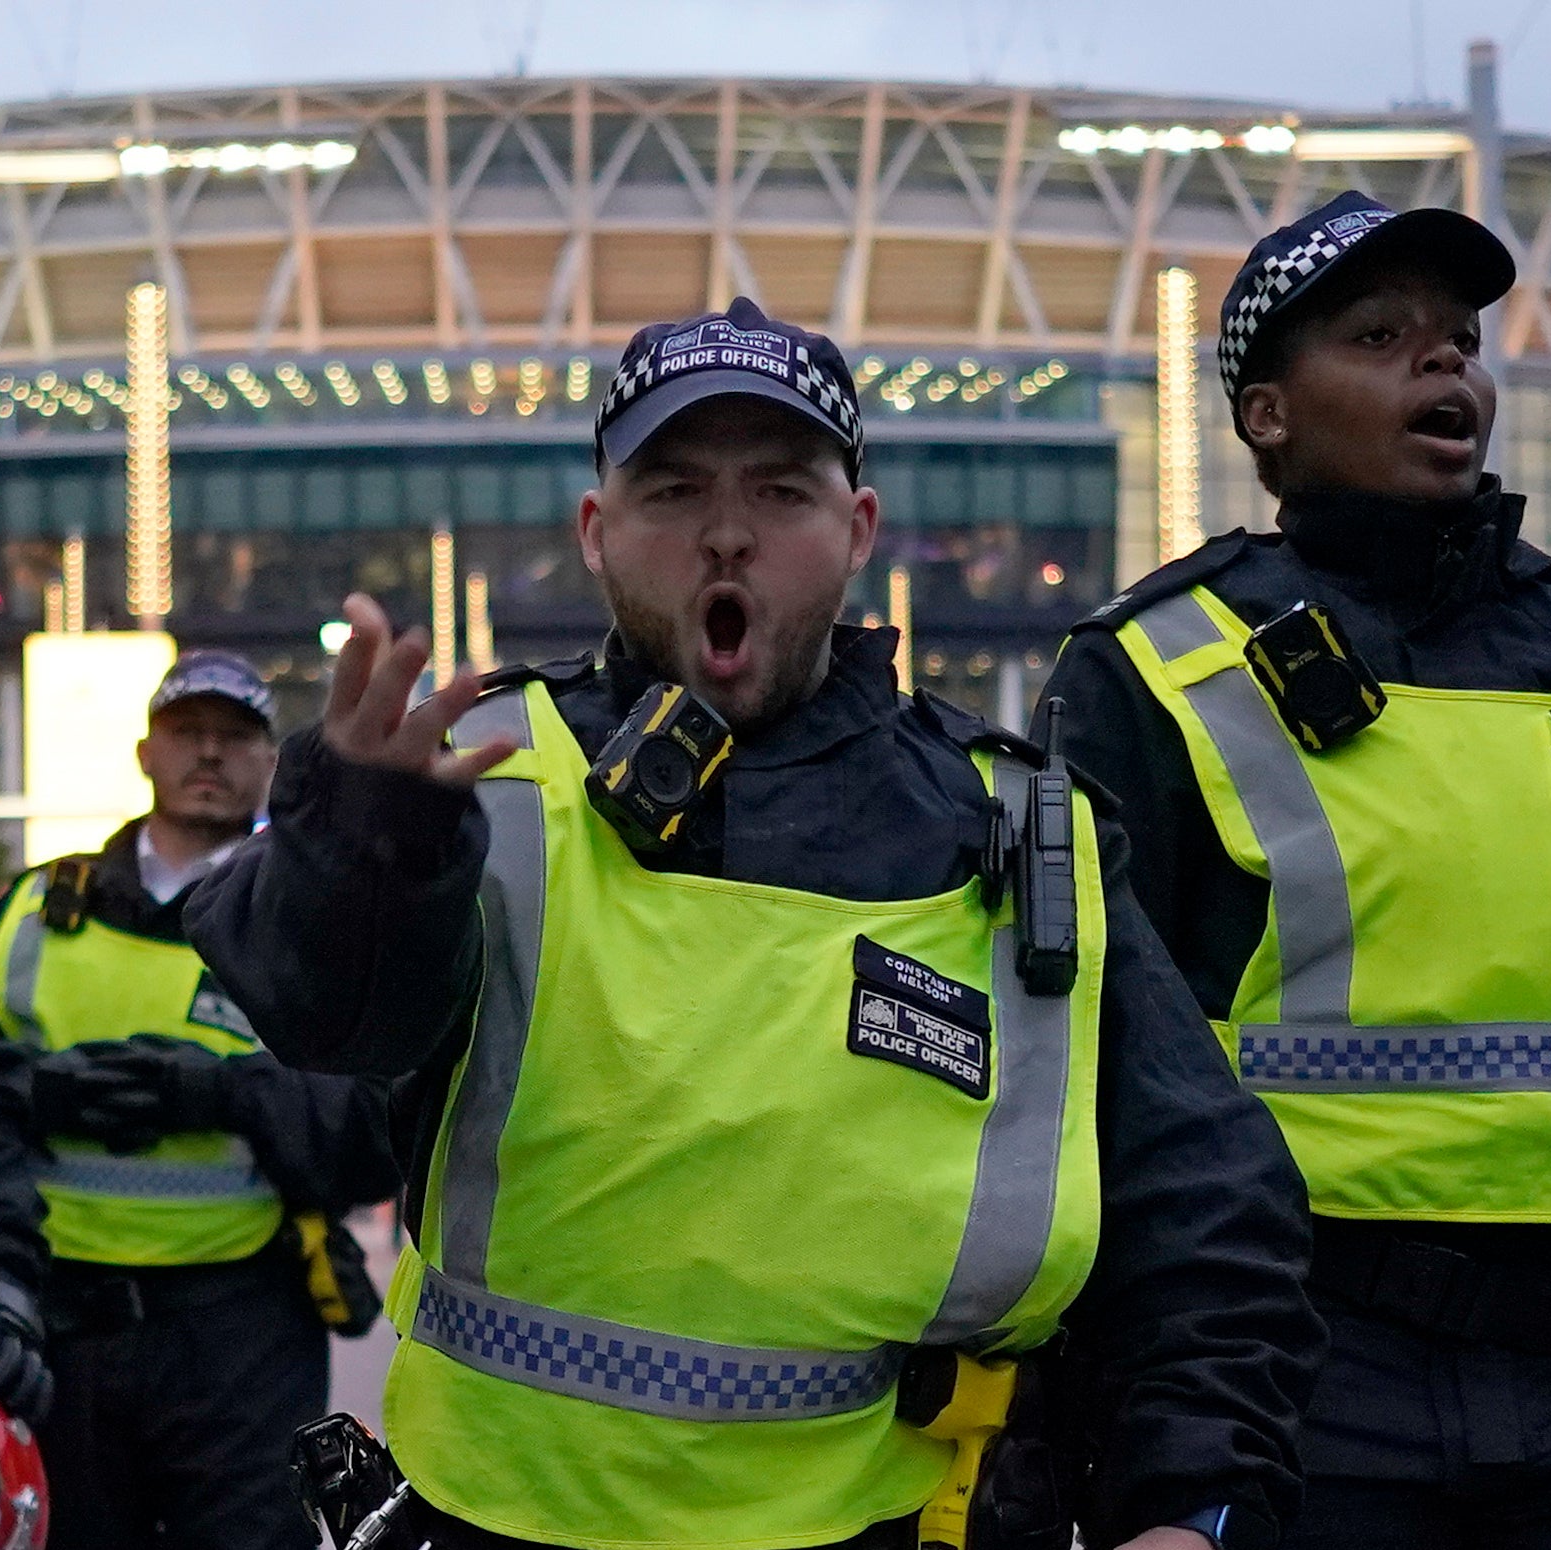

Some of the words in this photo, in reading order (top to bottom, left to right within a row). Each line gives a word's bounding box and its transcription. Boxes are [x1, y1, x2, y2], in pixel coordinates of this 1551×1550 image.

[718, 333, 772, 350] POLICE
[660, 350, 717, 376] POLICE
[721, 349, 789, 379] OFFICER
[884, 956, 962, 997] CONSTABLE
[897, 972, 950, 1004] NELSON
[905, 1009, 976, 1046] METROPOLITAN
[915, 1023, 967, 1055] POLICE
[857, 1027, 917, 1057] POLICE
[920, 1049, 981, 1086] OFFICER
